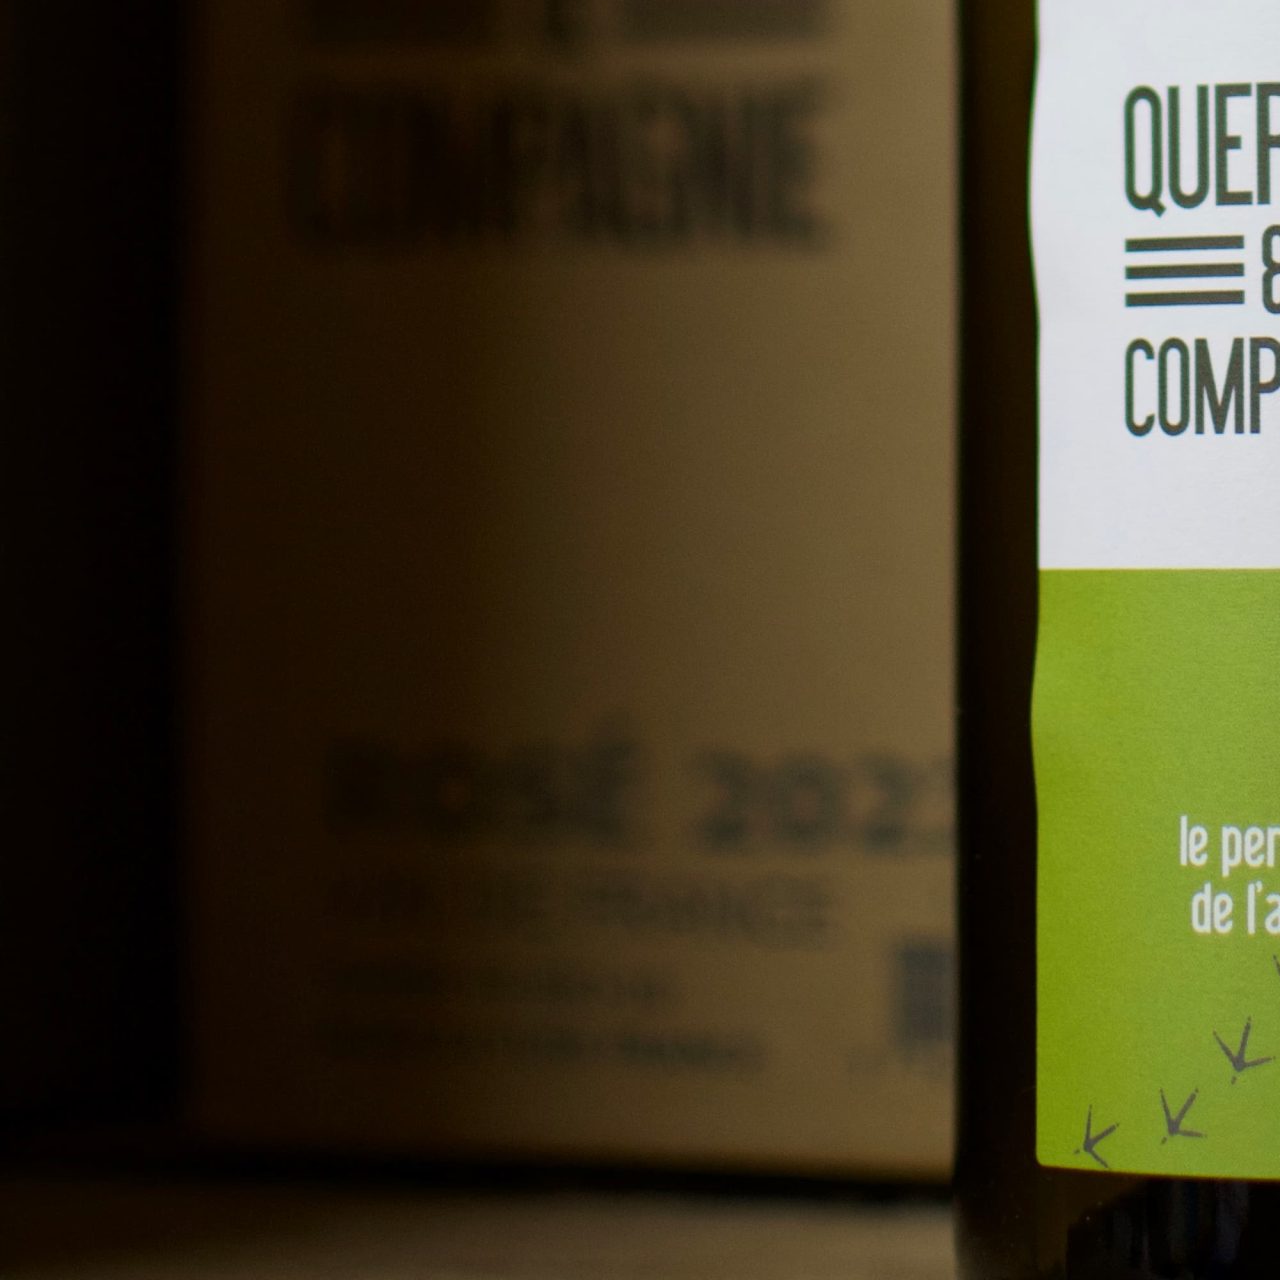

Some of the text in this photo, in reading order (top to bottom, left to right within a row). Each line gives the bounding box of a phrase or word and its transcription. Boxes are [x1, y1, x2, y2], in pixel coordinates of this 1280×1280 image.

[292, 84, 824, 248] COMPAGNIE
[1179, 814, 1209, 867] le
[1190, 881, 1235, 935] de
